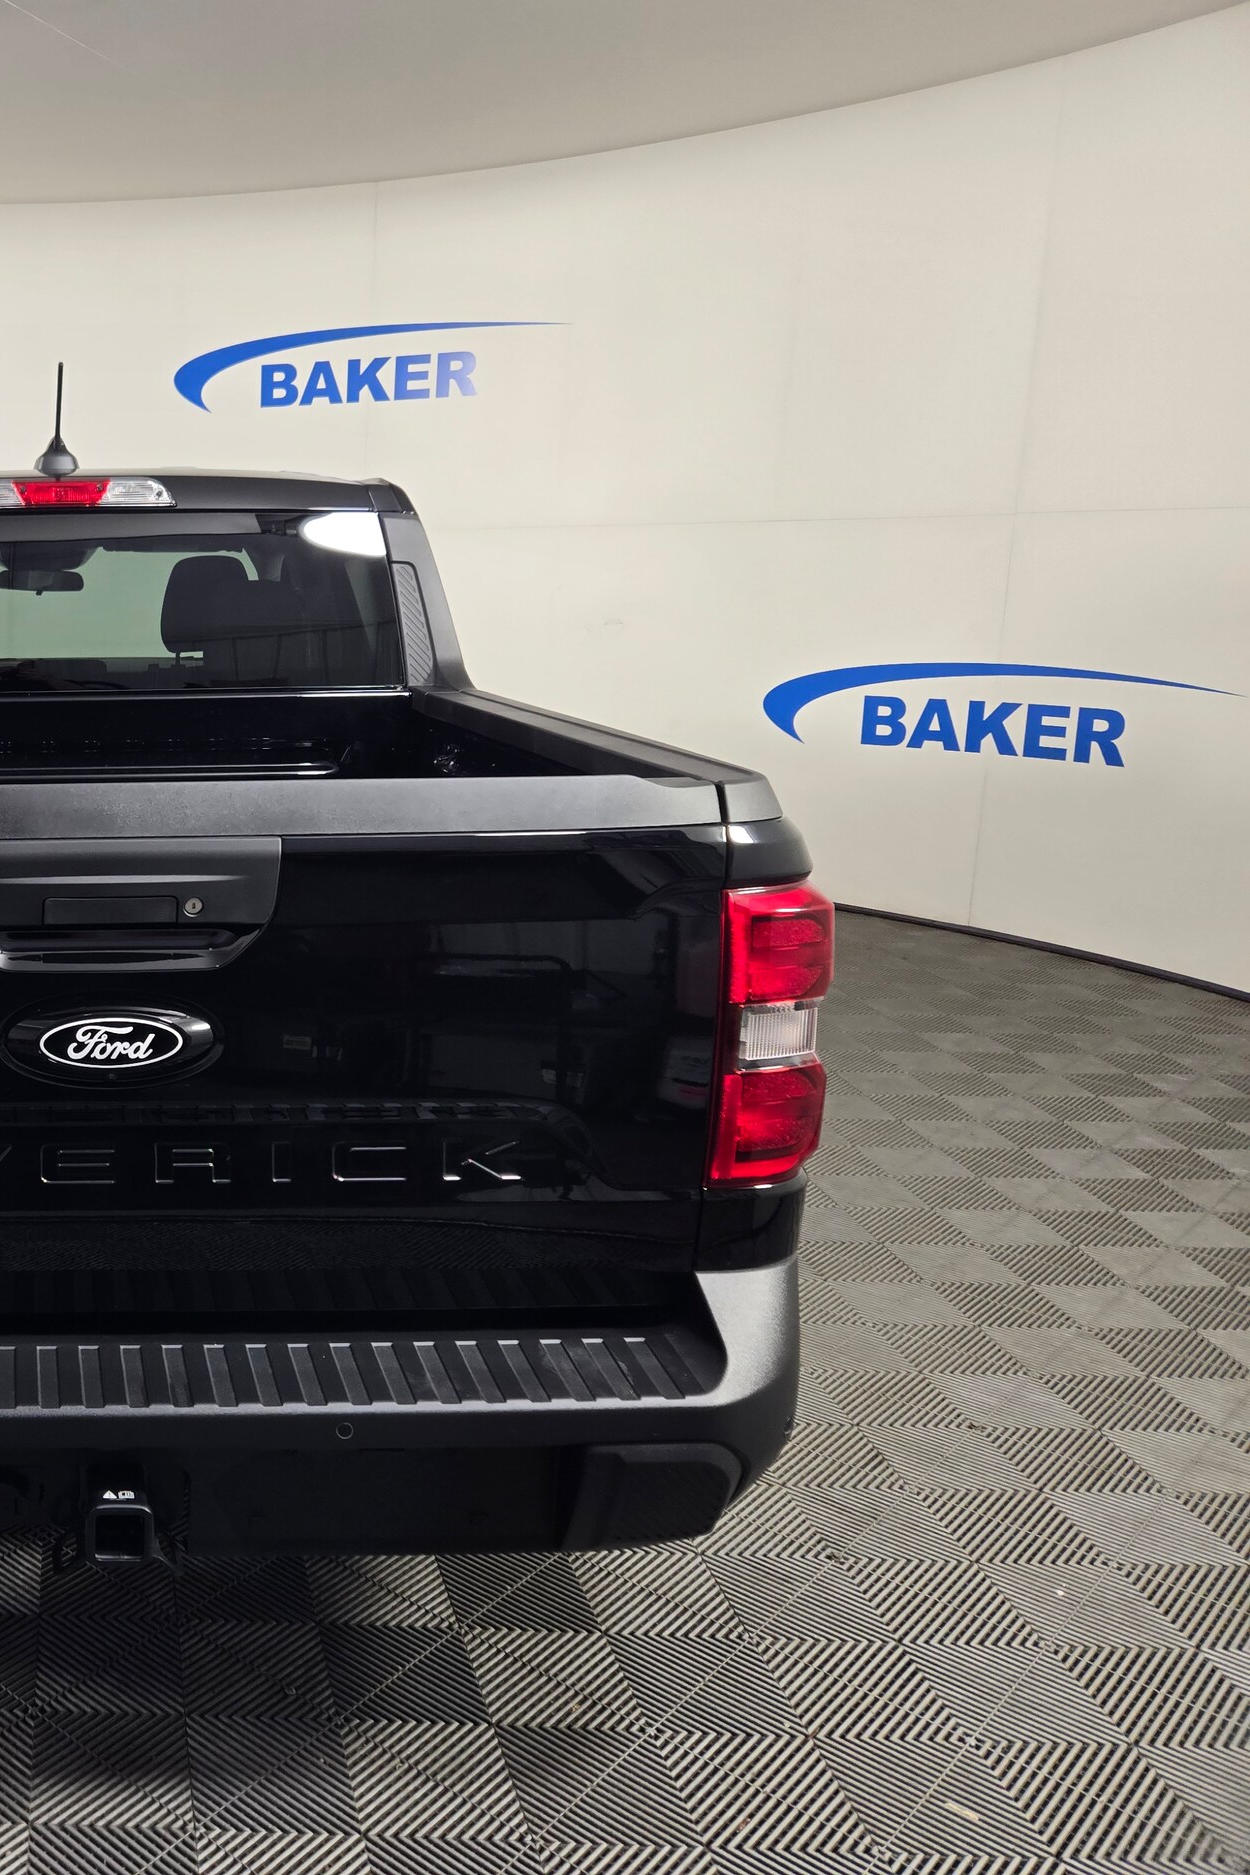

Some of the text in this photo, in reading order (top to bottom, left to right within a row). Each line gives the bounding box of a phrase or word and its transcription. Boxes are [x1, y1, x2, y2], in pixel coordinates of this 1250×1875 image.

[260, 350, 478, 409] BAKER
[859, 695, 1126, 768] BAKER
[67, 1024, 156, 1060] Ford
